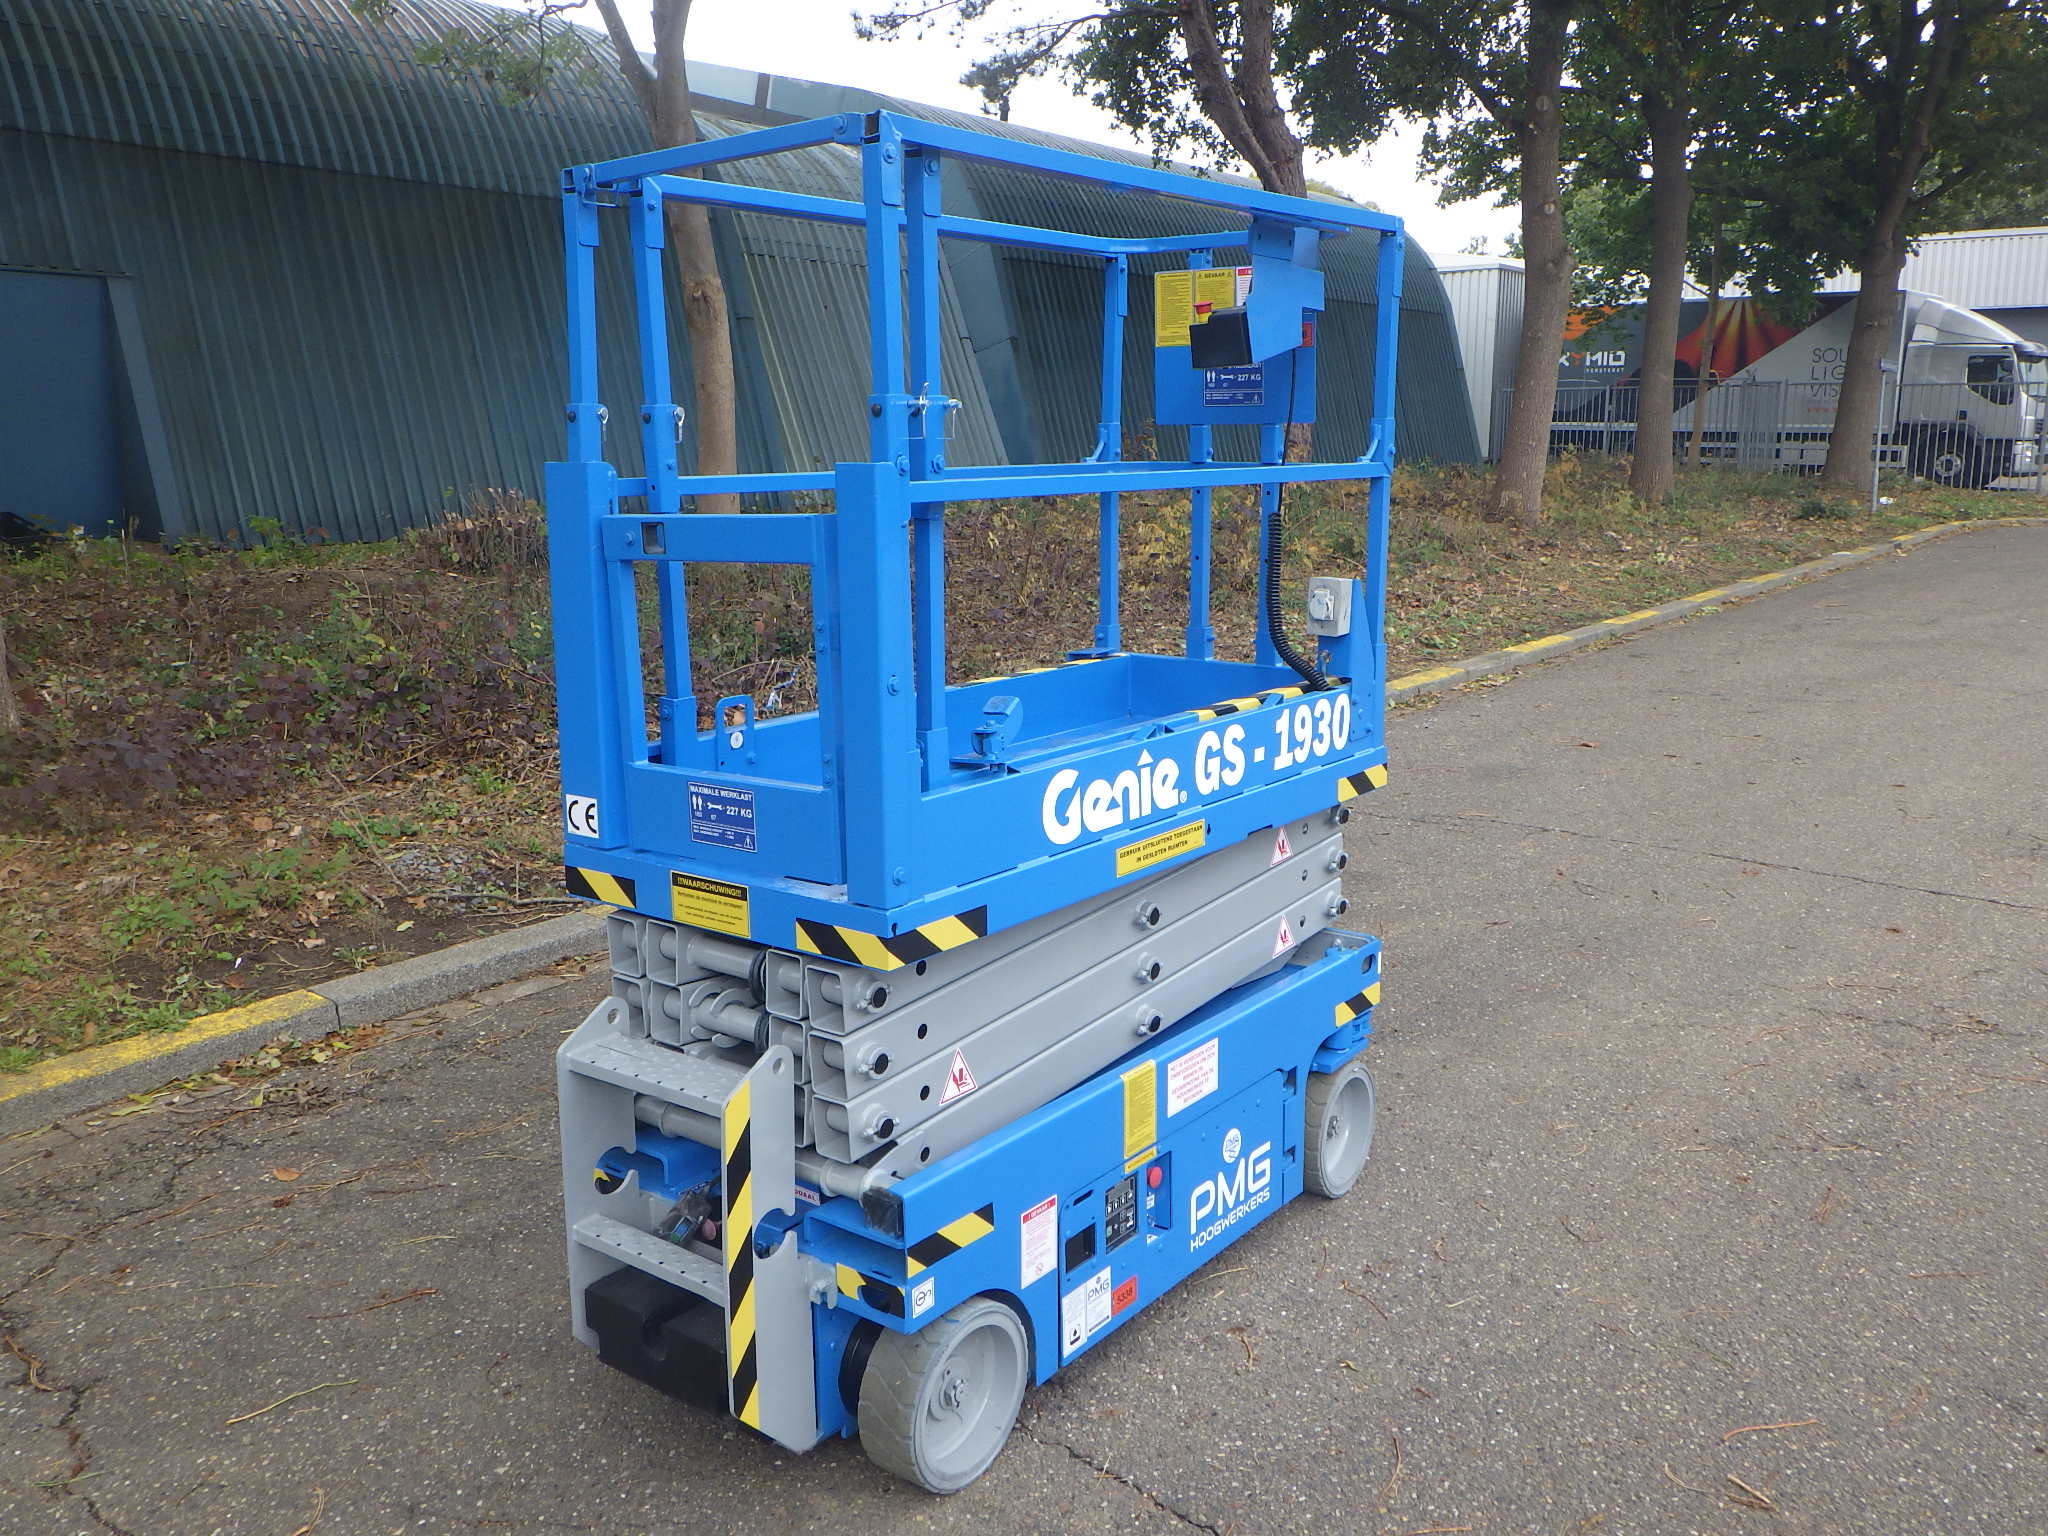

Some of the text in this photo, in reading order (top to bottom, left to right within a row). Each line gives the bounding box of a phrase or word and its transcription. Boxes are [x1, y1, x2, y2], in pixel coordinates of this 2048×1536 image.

[1042, 748, 1182, 845] Genie
[1194, 723, 1246, 795] GS
[1273, 693, 1352, 772] 1930
[567, 799, 597, 835] CE
[726, 805, 753, 819] 227 KG
[1190, 1140, 1271, 1236] PMG
[1190, 1186, 1271, 1253] HOOGWERKERS
[1087, 1277, 1110, 1302] PMG
